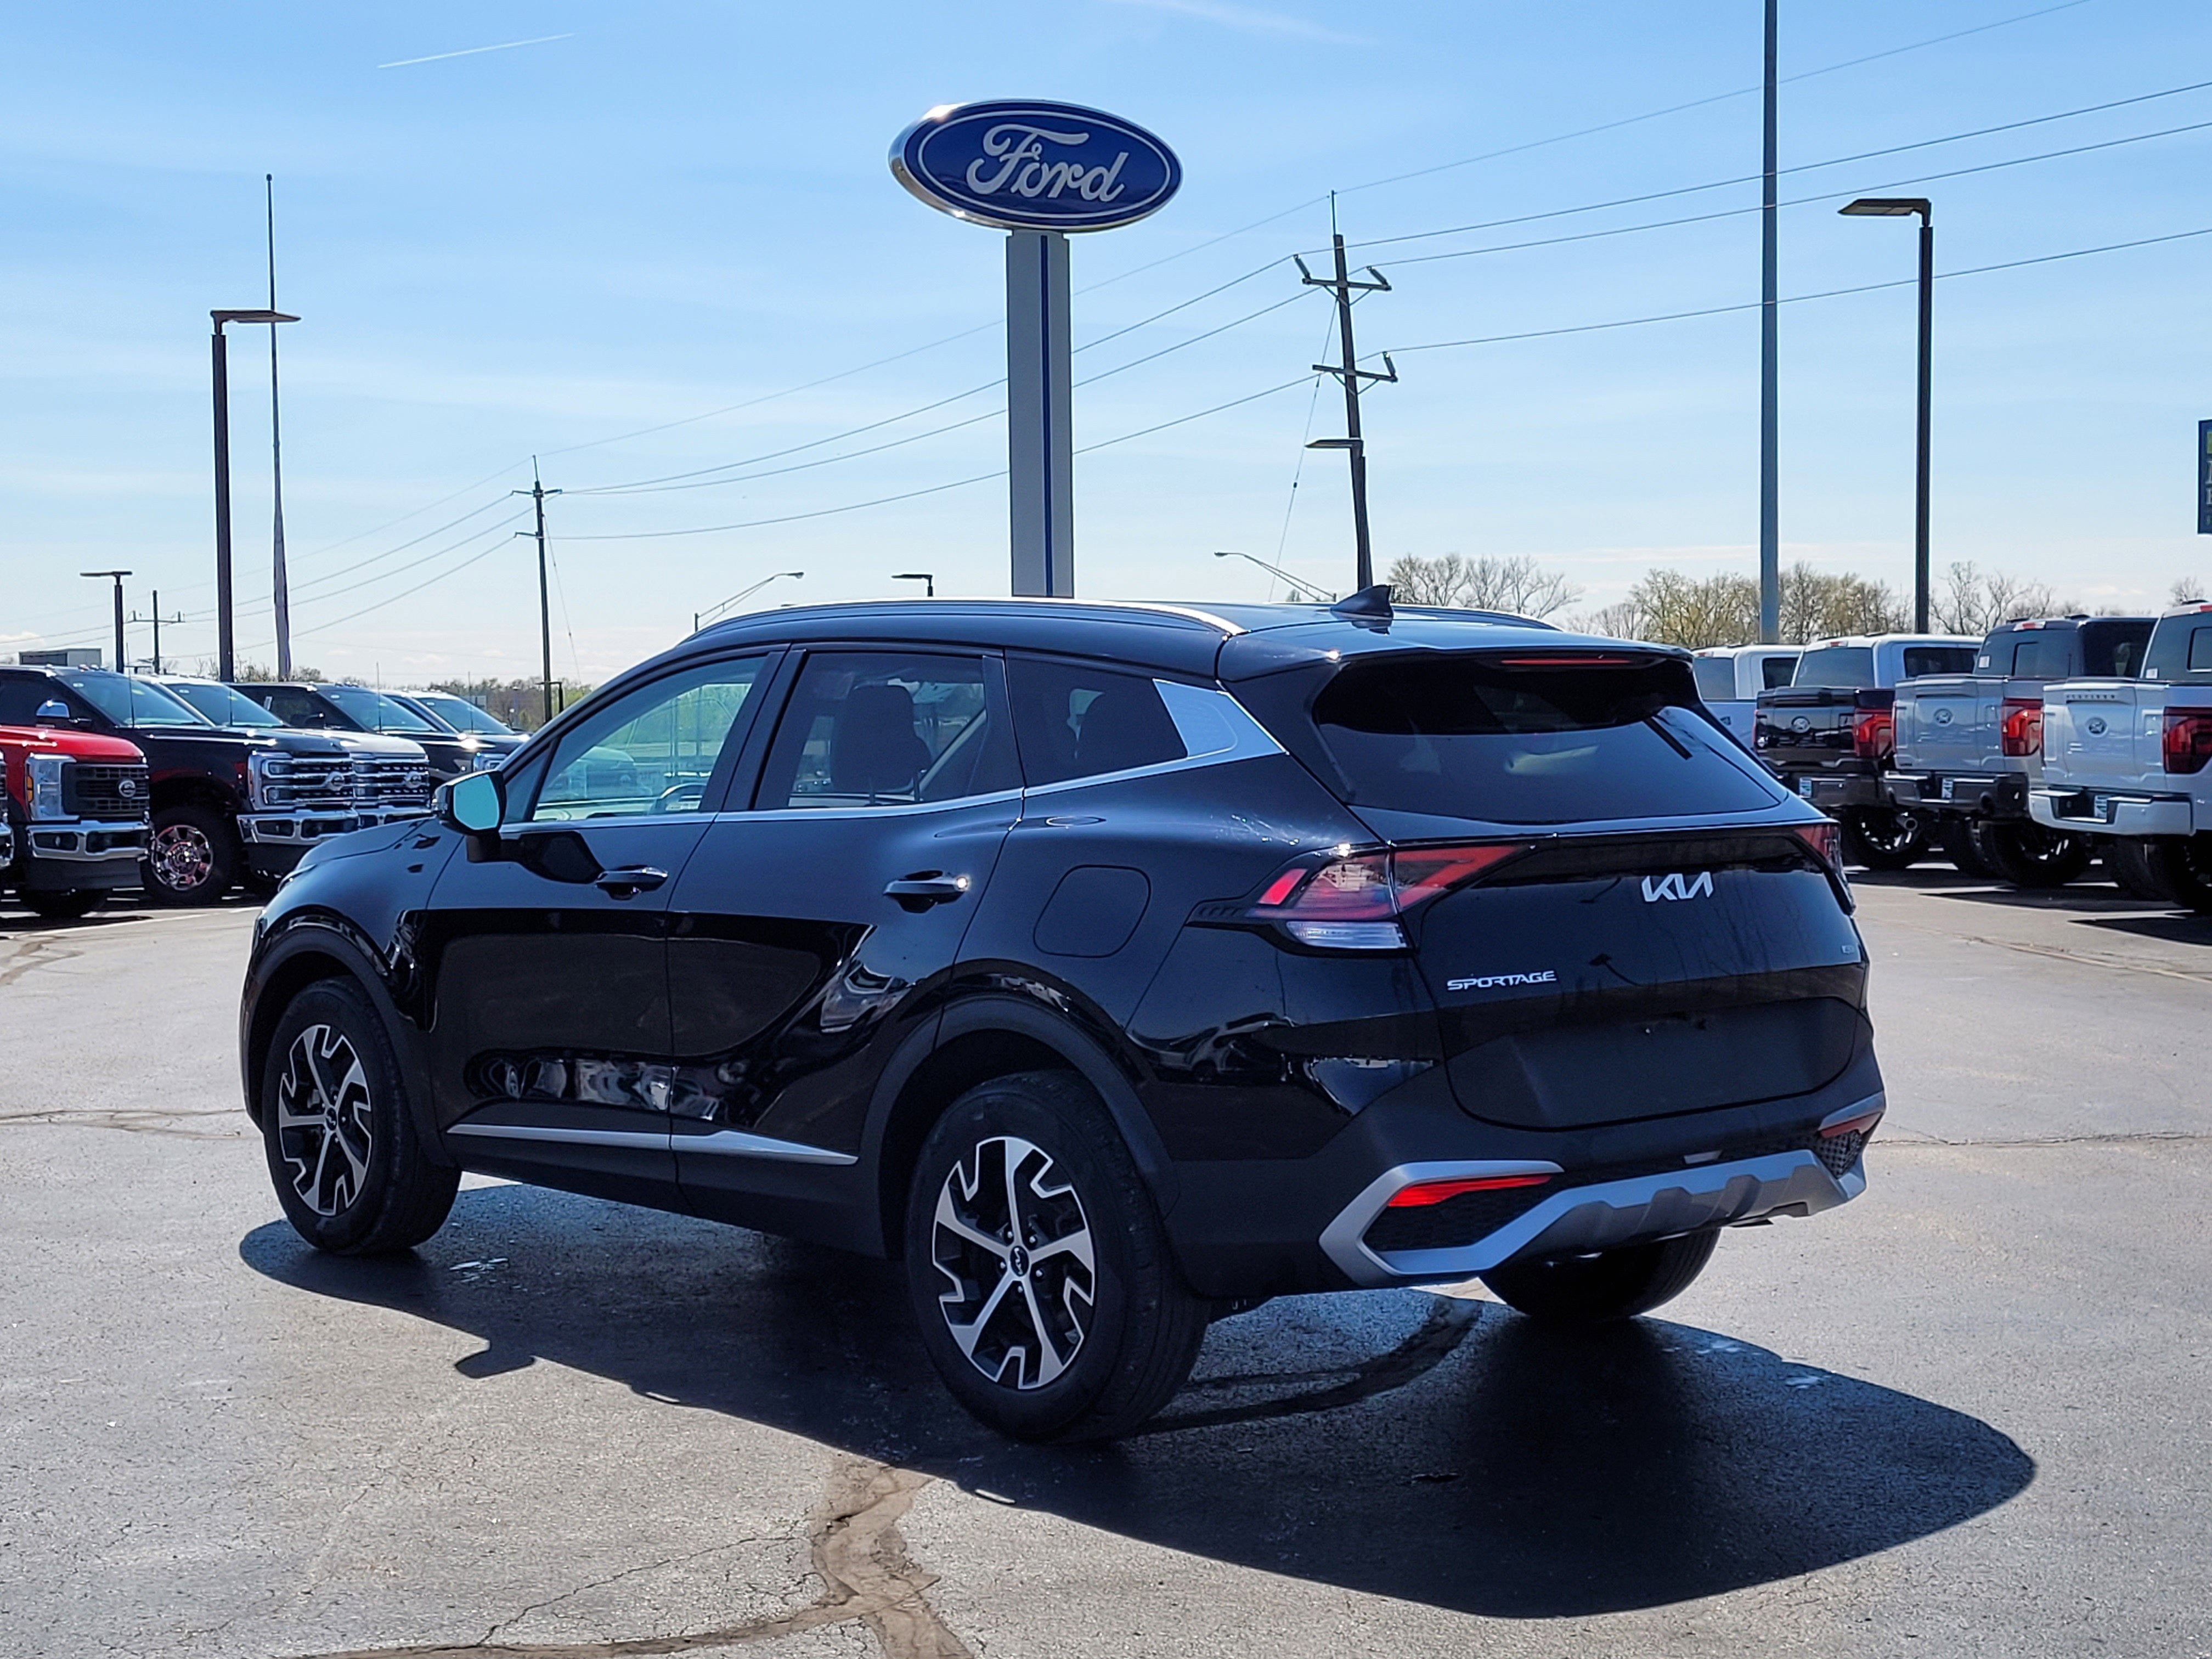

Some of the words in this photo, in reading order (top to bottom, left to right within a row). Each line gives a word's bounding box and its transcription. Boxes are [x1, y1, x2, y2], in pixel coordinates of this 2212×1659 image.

[966, 124, 1129, 202] Ford
[1641, 871, 1714, 902] KIA
[1447, 970, 1556, 990] SPORTAGE
